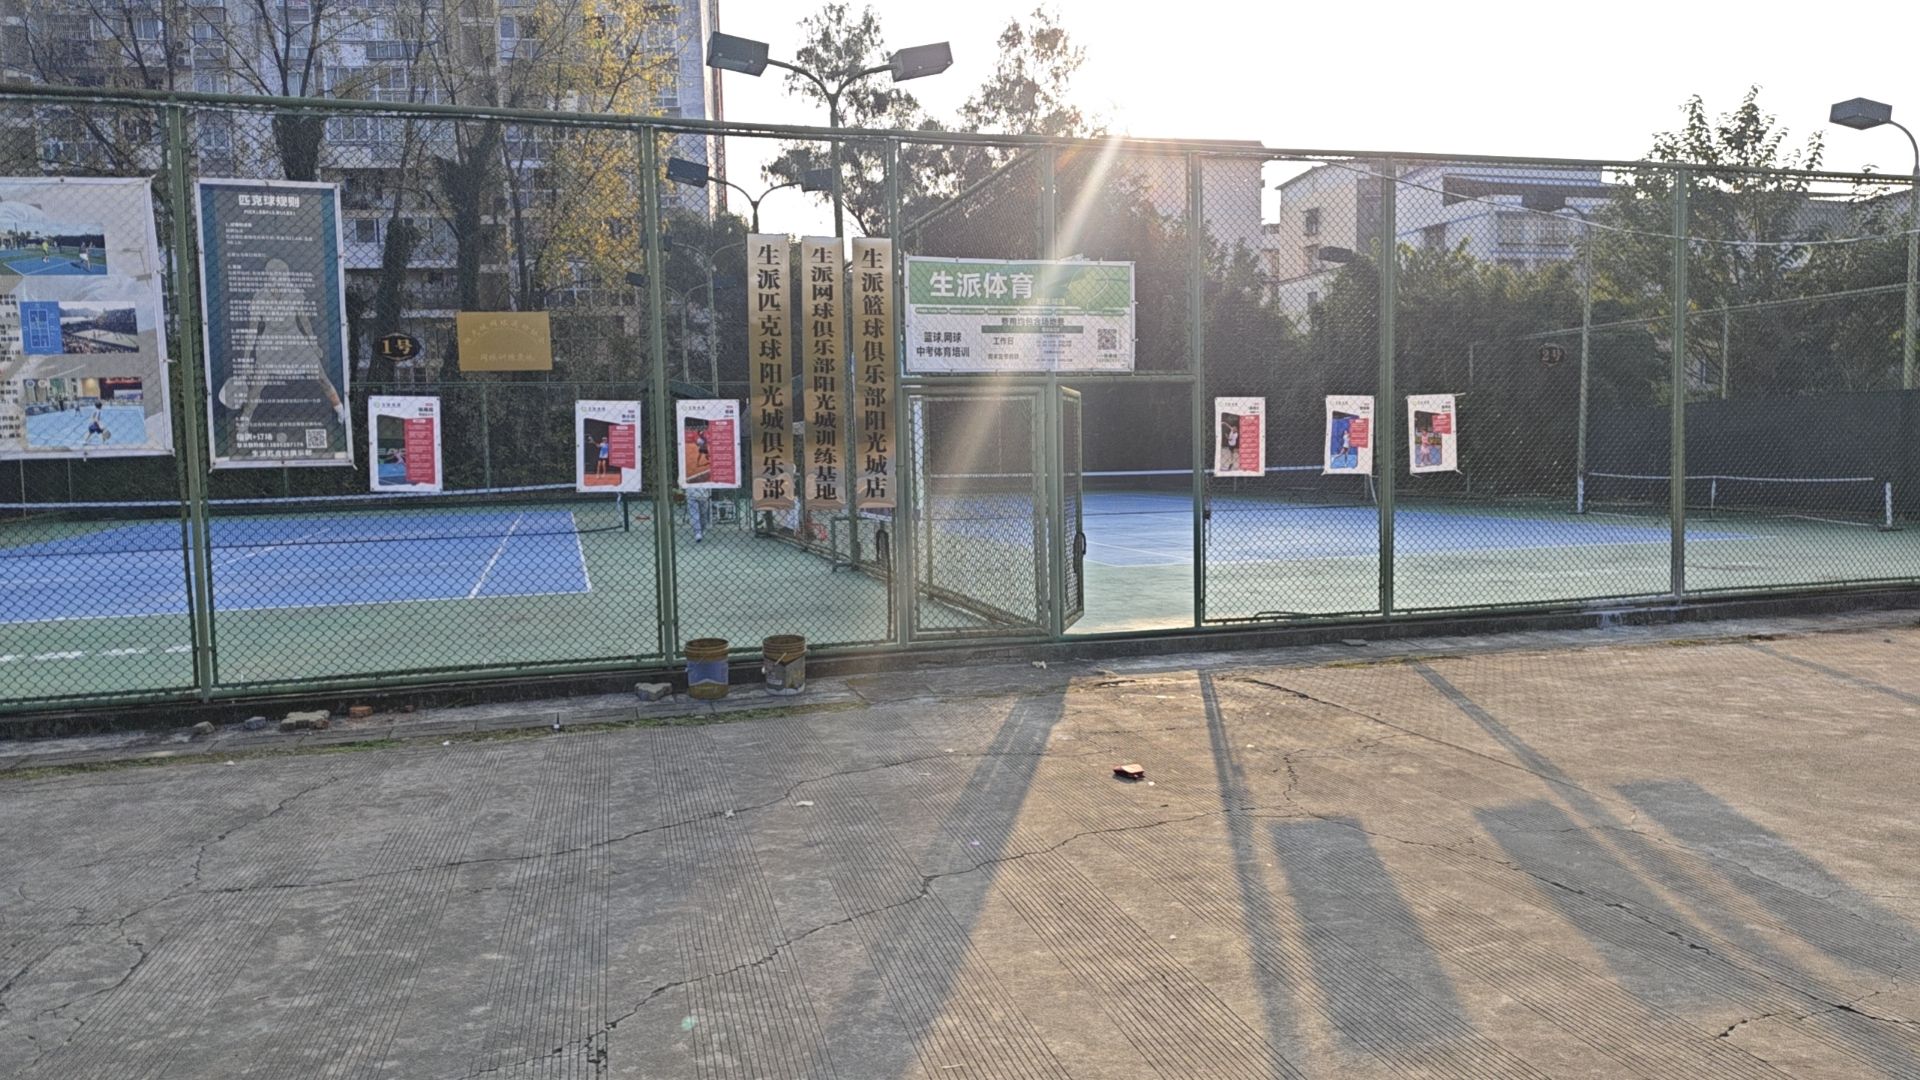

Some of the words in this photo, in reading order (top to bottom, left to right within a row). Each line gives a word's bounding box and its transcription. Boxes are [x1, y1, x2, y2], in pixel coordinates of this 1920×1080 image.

[239, 194, 300, 208] 匹克球规则
[929, 271, 1034, 299] 生派体育
[382, 339, 412, 355] 1号
[916, 346, 970, 357] 中考体育培训
[992, 337, 1015, 345] 工作日
[757, 244, 785, 500] 生派匹克球阳光城俱乐部
[811, 247, 838, 500] 生派网球俱乐部阳光城训练基地
[861, 248, 887, 499] 生派篮球俱乐部阳光城店
